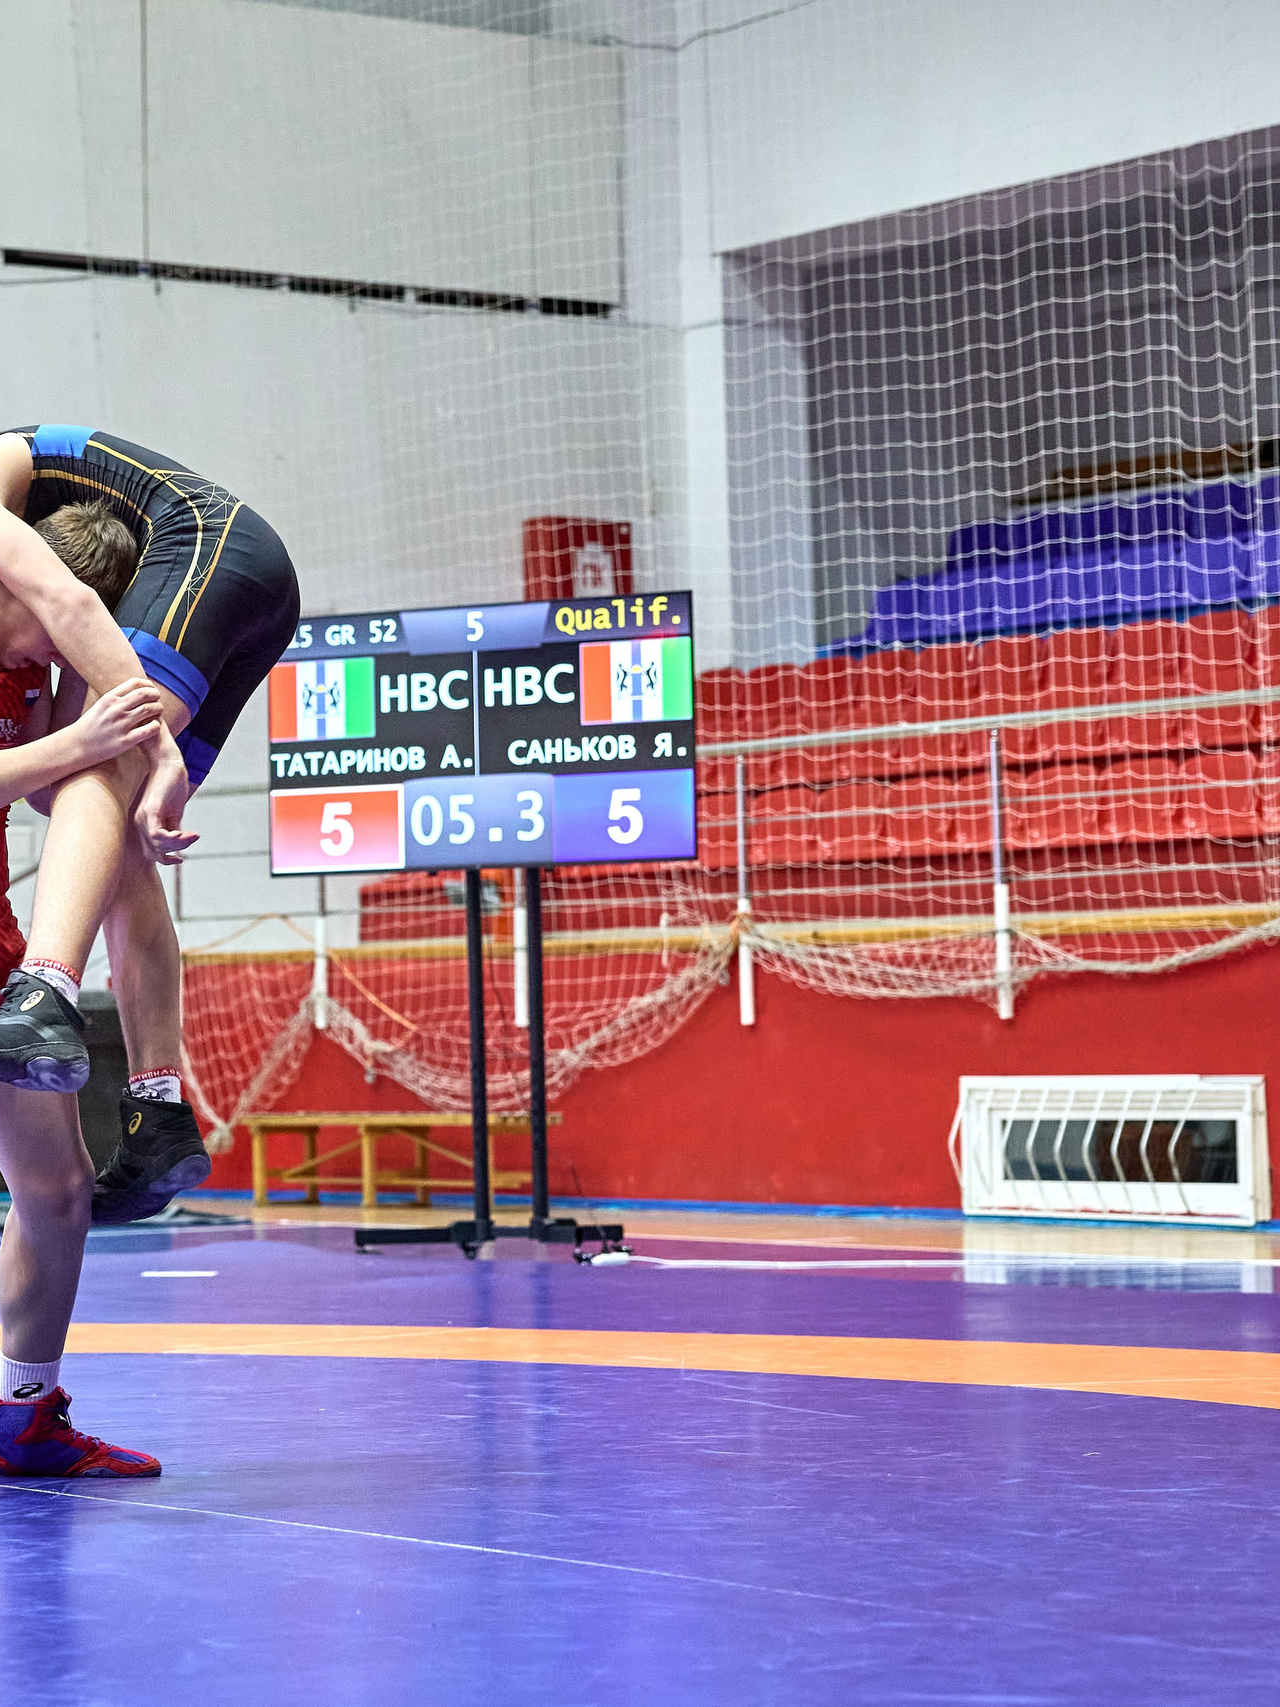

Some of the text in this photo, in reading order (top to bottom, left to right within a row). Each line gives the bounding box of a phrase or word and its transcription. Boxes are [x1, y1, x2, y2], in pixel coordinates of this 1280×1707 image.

[325, 624, 356, 646] GR
[369, 618, 398, 644] 52
[466, 610, 484, 642] 5
[554, 595, 682, 636] Qualif.
[379, 670, 469, 714] НВС
[483, 663, 576, 708] НВС
[271, 743, 474, 778] ТАТАРИНОВ А.
[507, 731, 688, 766] САНЬКОВ Я.
[318, 801, 355, 857] 5
[410, 789, 546, 846] 05.3
[606, 787, 644, 845] 5
